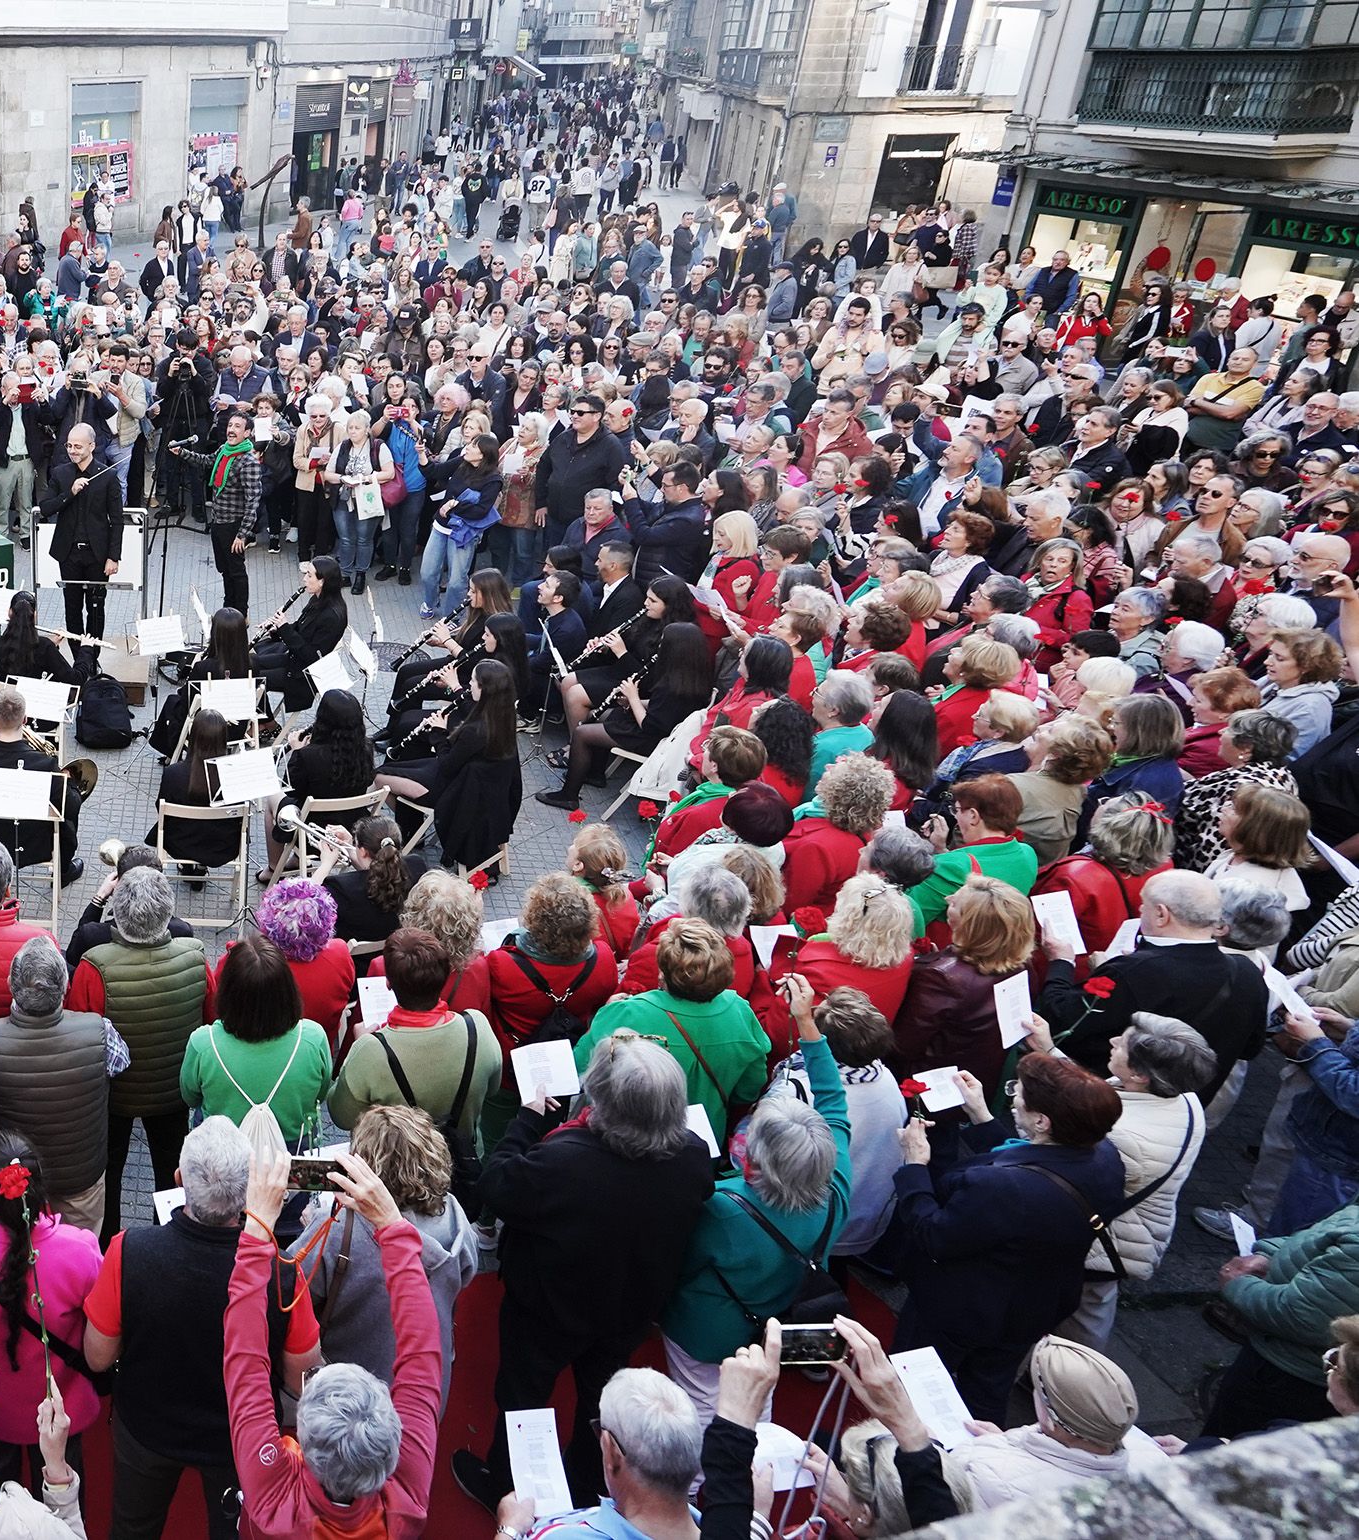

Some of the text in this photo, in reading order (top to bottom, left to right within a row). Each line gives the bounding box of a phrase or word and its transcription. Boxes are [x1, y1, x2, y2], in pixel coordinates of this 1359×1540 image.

[531, 180, 546, 192] 87
[1044, 191, 1124, 214] ARESSO
[1263, 218, 1359, 246] ARESS
